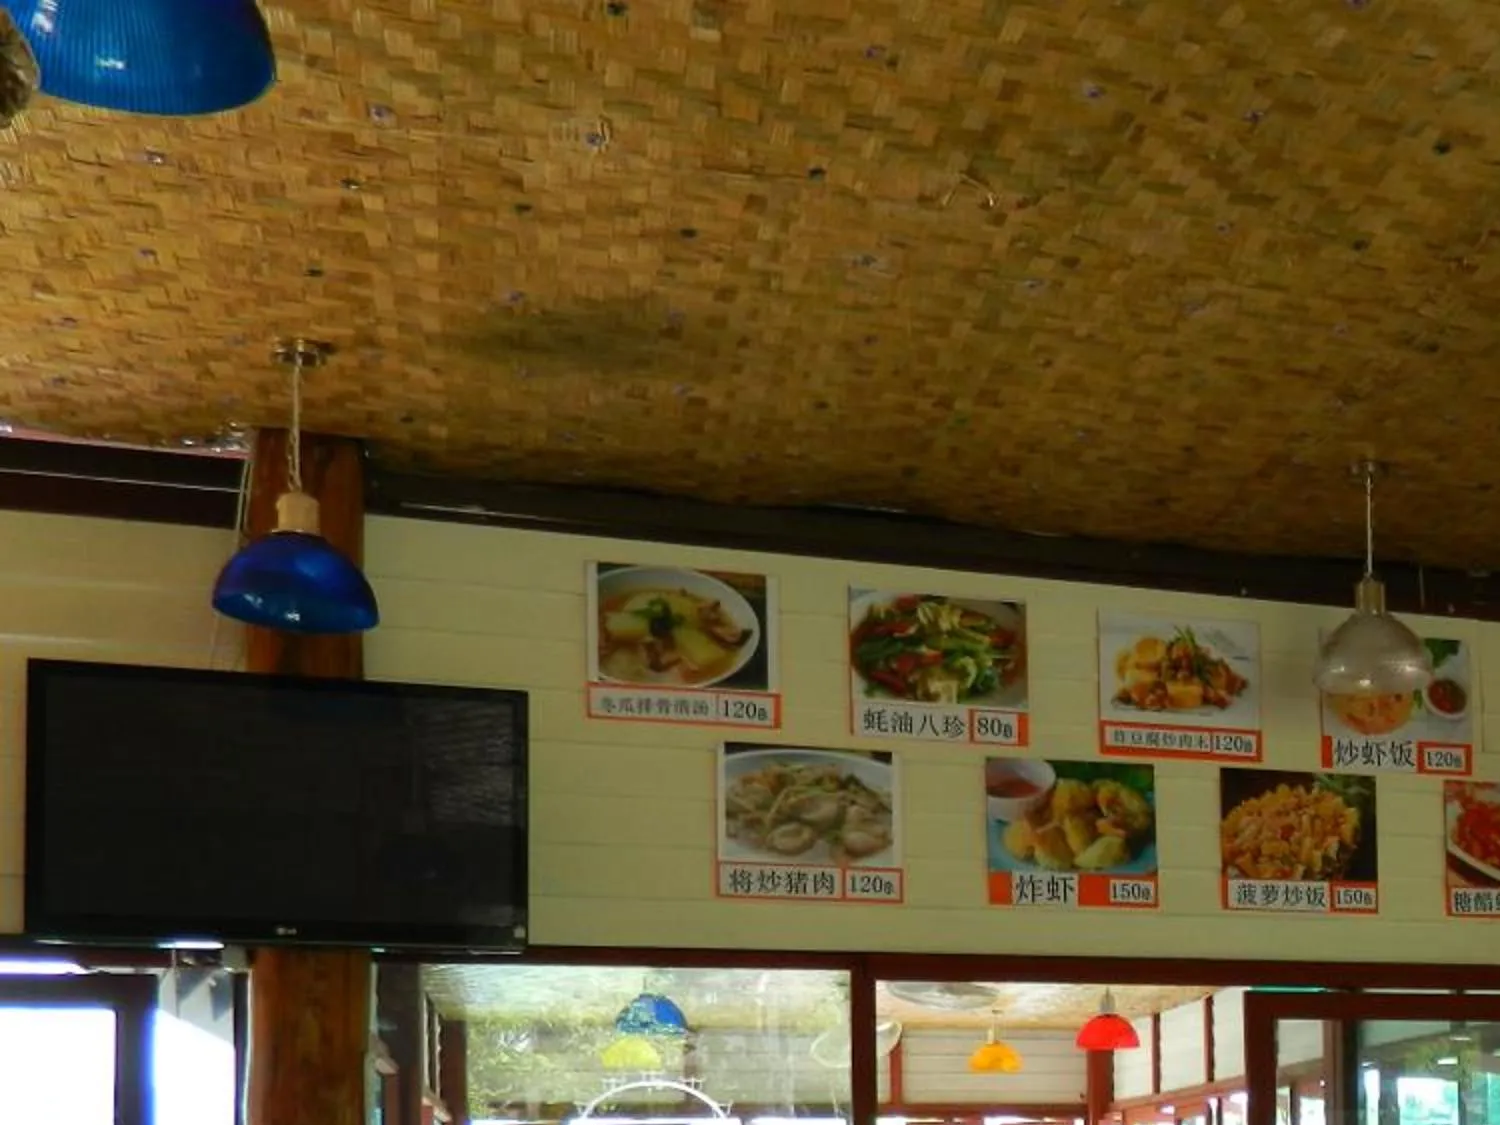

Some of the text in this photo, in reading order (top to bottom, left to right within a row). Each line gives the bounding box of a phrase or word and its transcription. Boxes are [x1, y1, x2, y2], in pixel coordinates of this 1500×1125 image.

[863, 708, 965, 738] 蚝油八珍
[1336, 739, 1415, 768] 炒虾饭
[1016, 874, 1076, 904] 炸虾
